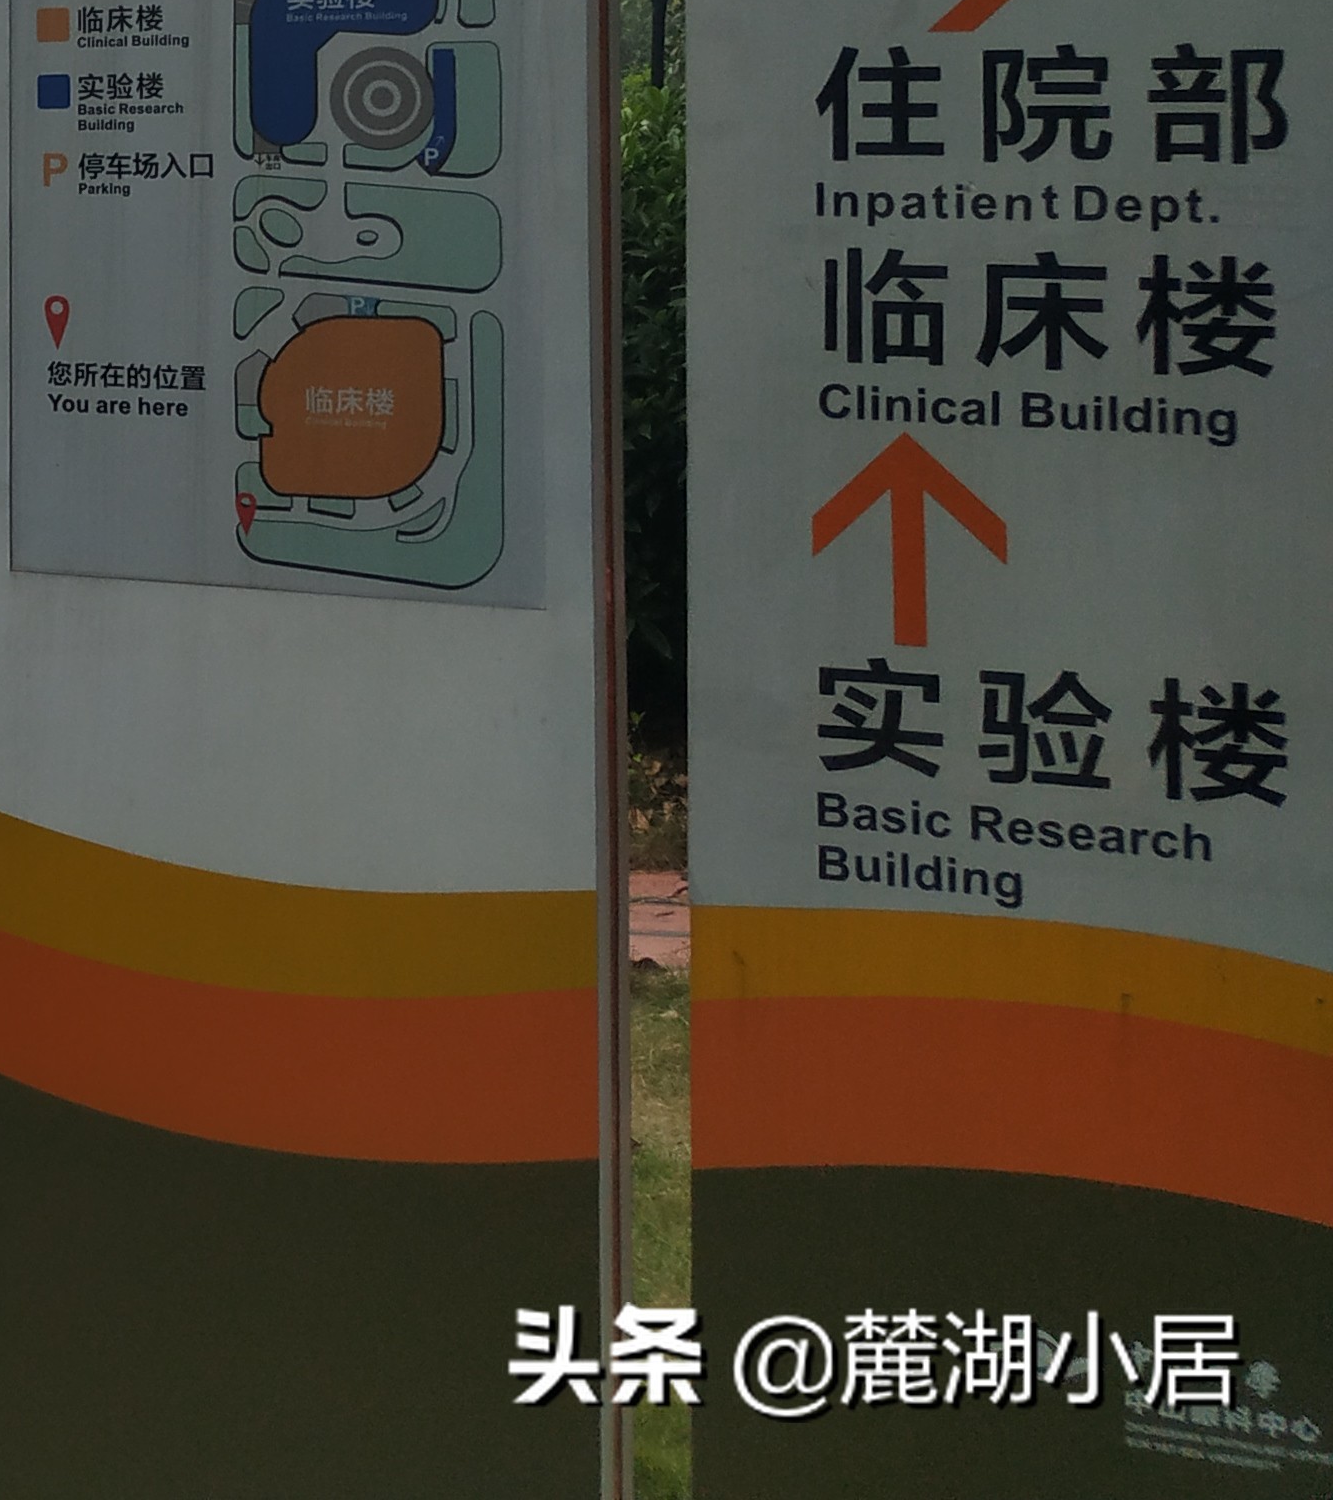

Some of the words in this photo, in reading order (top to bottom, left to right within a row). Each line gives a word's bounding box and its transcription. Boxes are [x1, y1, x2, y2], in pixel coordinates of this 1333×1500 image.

[77, 3, 164, 34] 临床楼
[286, 13, 313, 23] Basic
[315, 12, 363, 22] Research
[364, 11, 408, 22] Building
[77, 35, 128, 49] Clinical
[131, 34, 190, 49] Building
[77, 72, 165, 101] 实验楼
[77, 103, 116, 116] Basic
[119, 102, 185, 115] Research
[815, 43, 1289, 165] 住院部
[77, 118, 135, 133] Building
[42, 152, 69, 188] P
[77, 151, 215, 181] 停车场入口
[424, 148, 440, 167] P
[78, 182, 131, 197] Parking
[815, 181, 1060, 227] Inpatient
[1073, 184, 1220, 231] Dept.
[351, 296, 366, 315] P
[823, 247, 1277, 378] 临床楼
[47, 360, 207, 392] 您所在的位置
[47, 393, 90, 414] You
[95, 400, 132, 415] are
[137, 396, 190, 417] here
[304, 385, 395, 416] 临床楼
[818, 383, 1001, 427] Clinical
[1020, 391, 1238, 447] Building
[817, 657, 1289, 807] 实验楼
[817, 791, 951, 839] Basic
[970, 803, 1213, 861] Research
[817, 844, 1024, 908] Building
